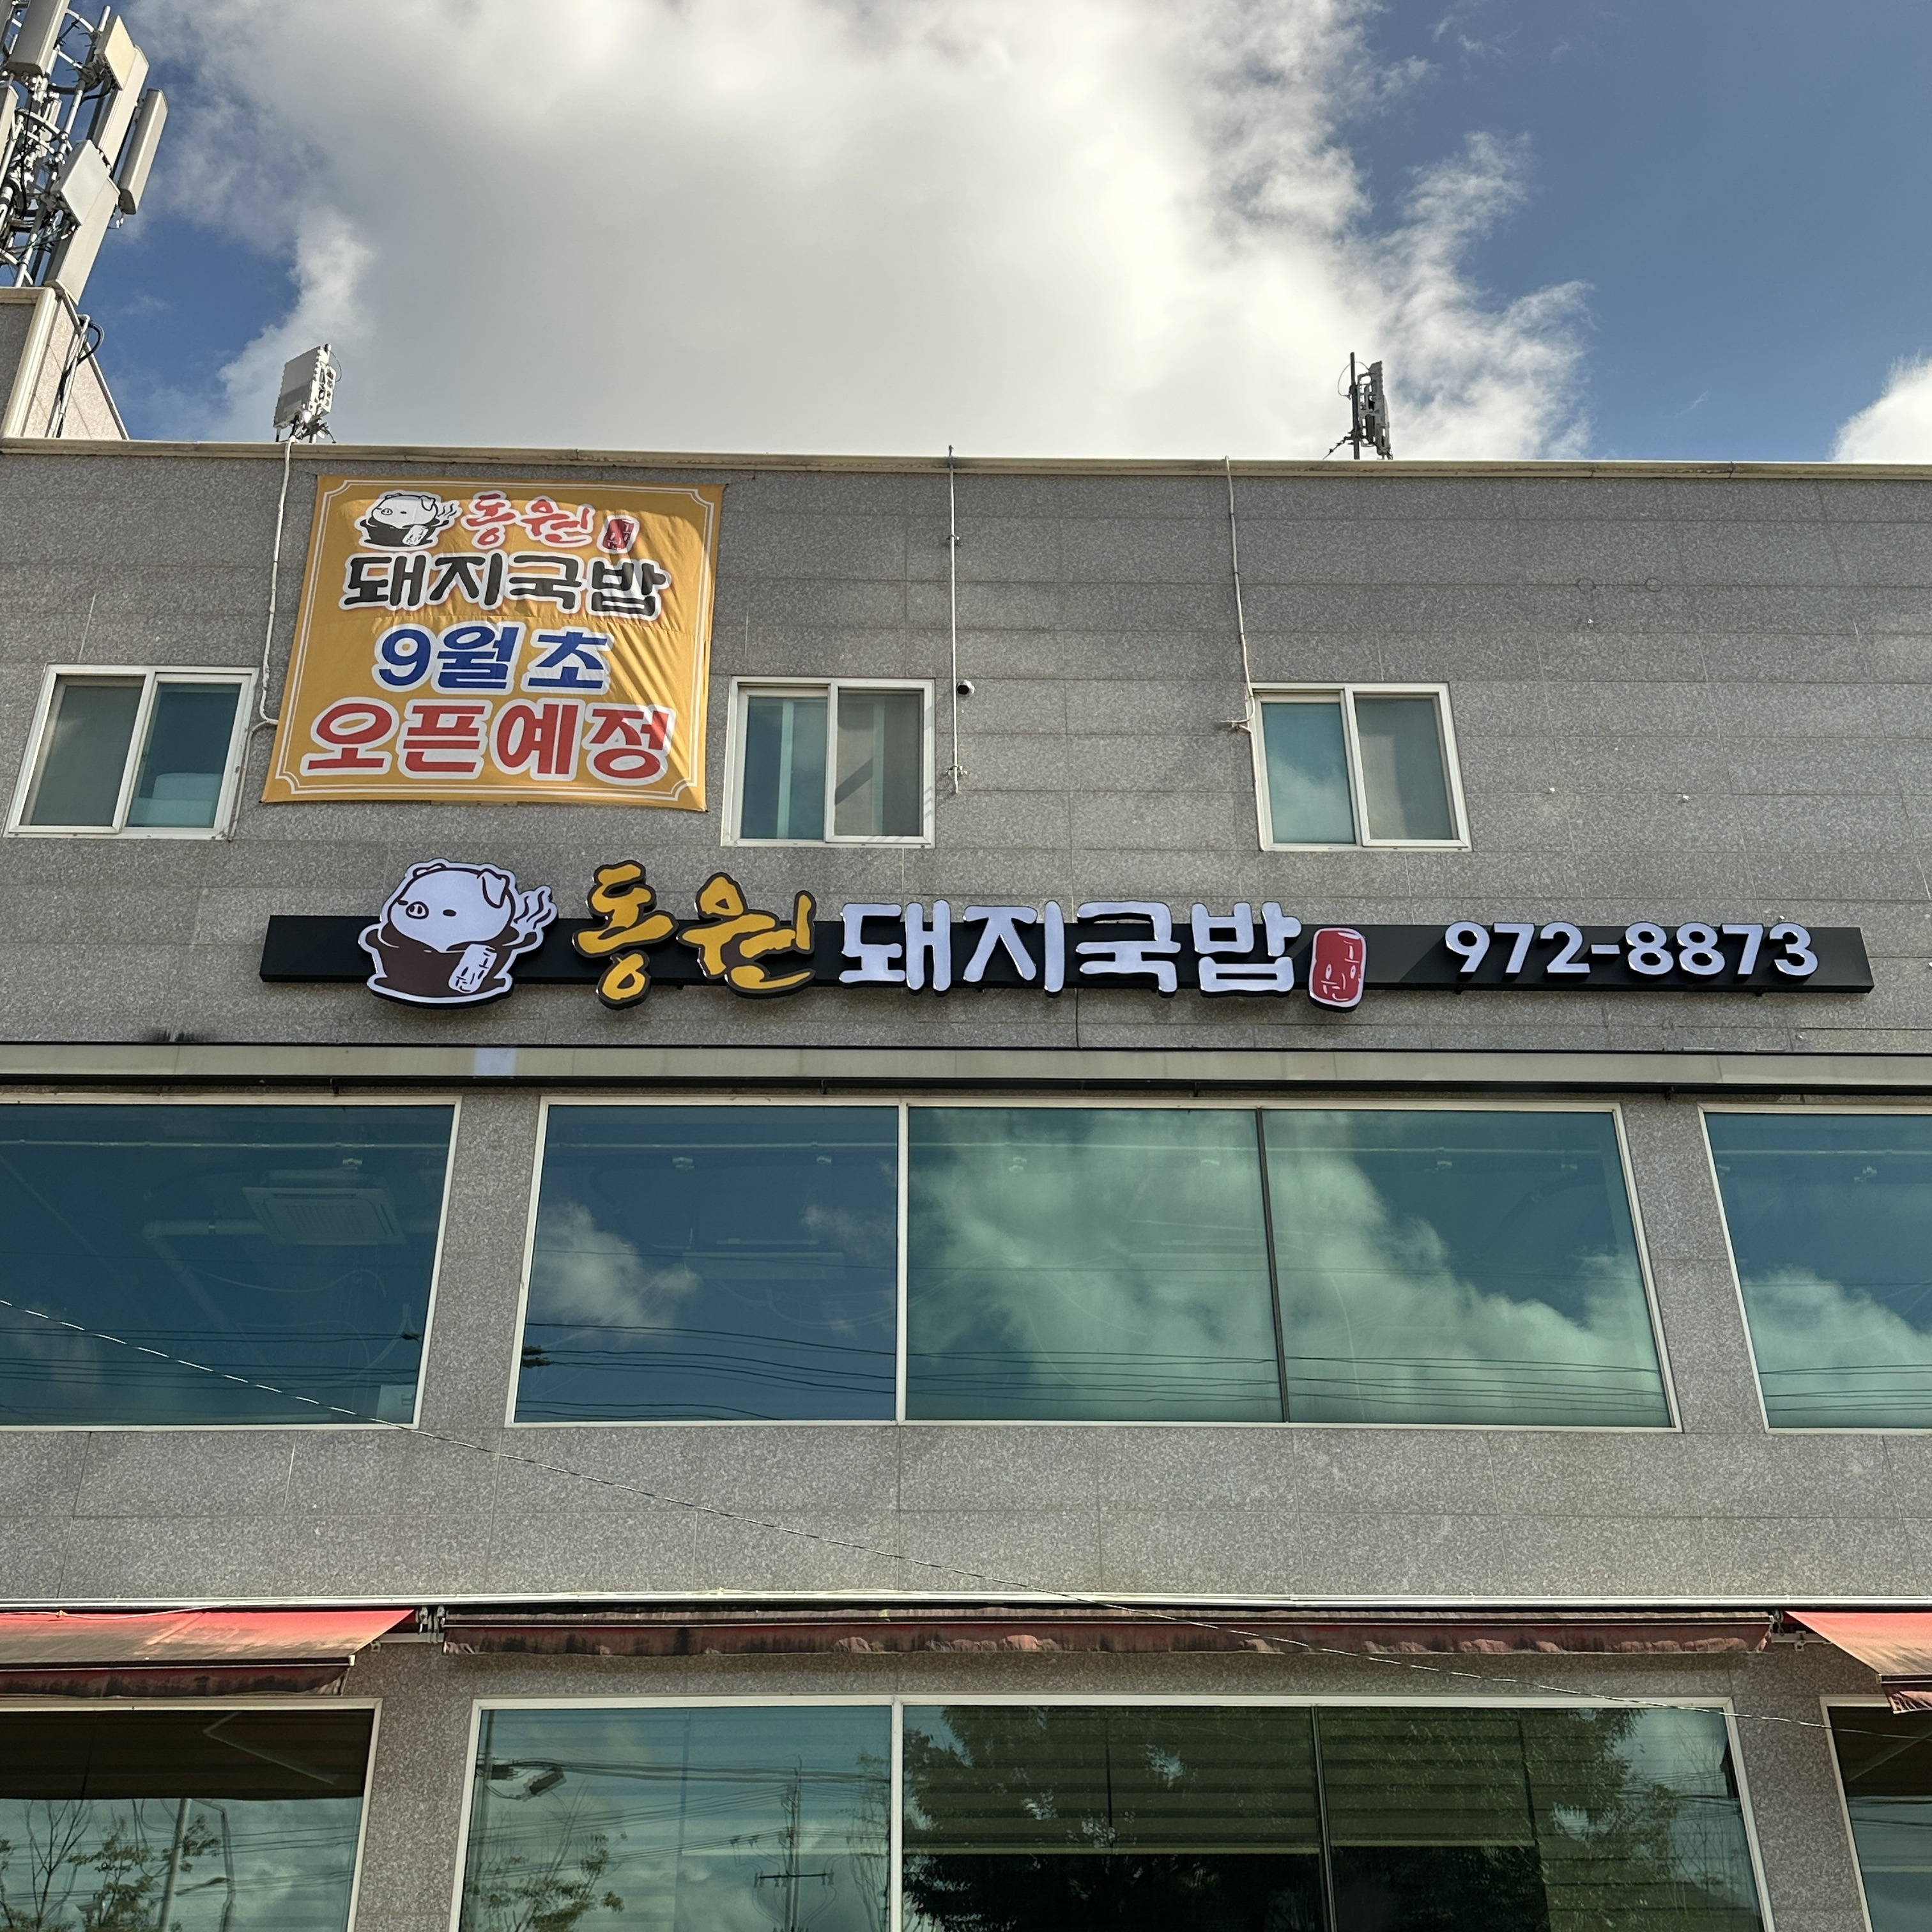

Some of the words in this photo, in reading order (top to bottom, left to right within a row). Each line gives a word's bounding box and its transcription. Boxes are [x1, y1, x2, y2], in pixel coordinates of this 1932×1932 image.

[462, 493, 590, 546] 동원
[343, 553, 666, 617] 돼지국밥
[307, 703, 669, 779] 오픈예정
[577, 863, 814, 1000] 동원
[838, 900, 1302, 993] 돼지국밥
[1445, 921, 1819, 976] 972-8873
